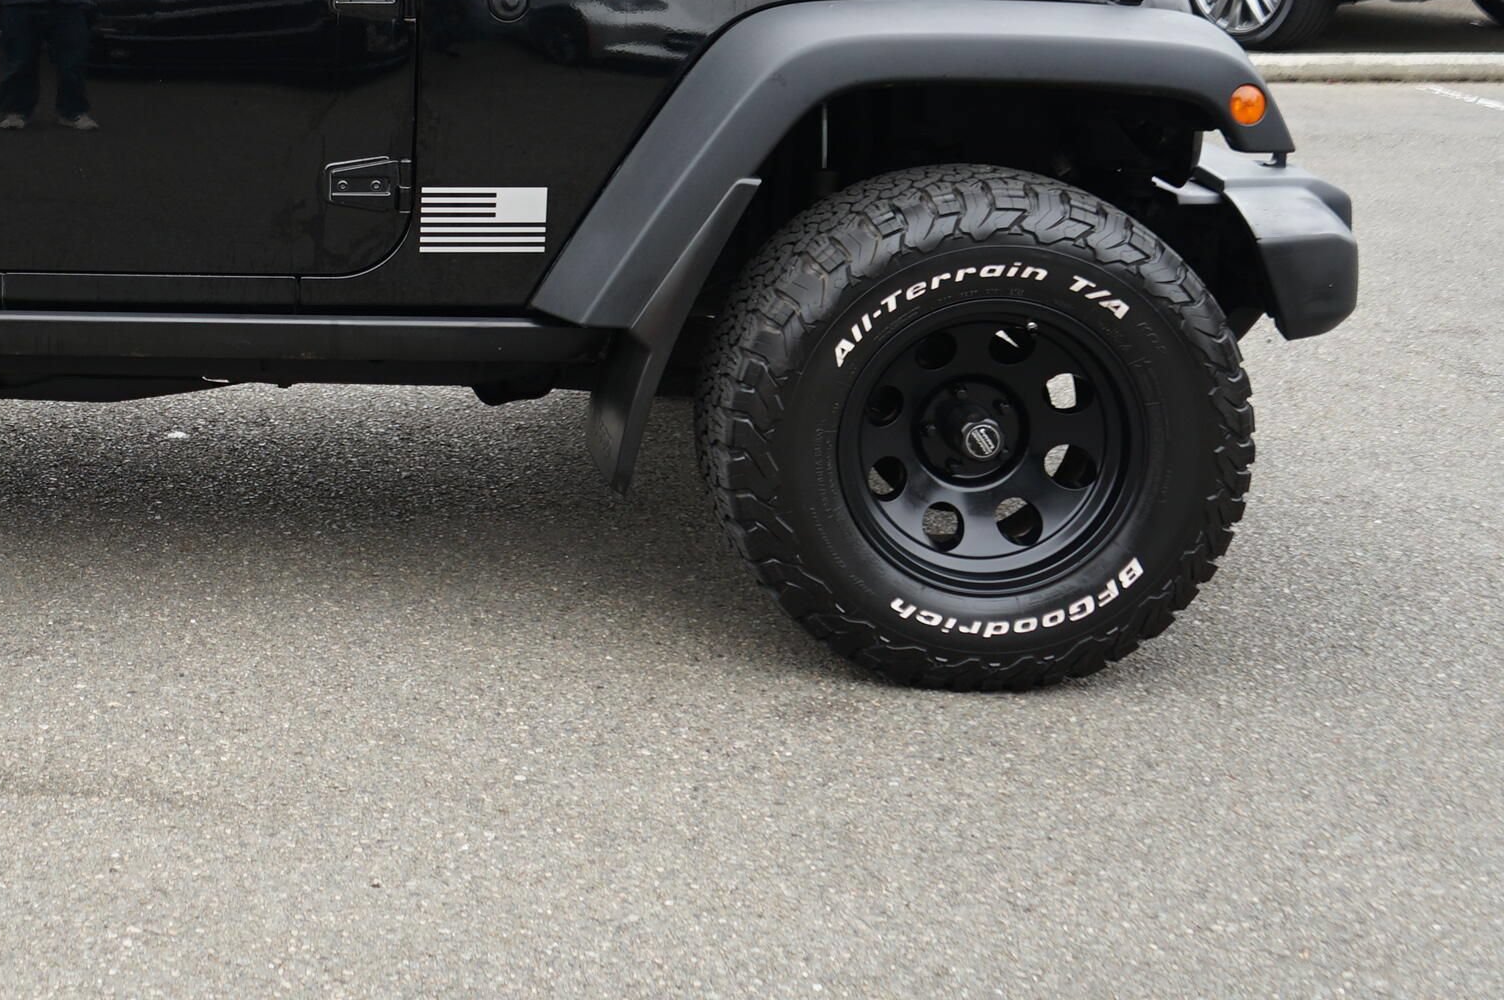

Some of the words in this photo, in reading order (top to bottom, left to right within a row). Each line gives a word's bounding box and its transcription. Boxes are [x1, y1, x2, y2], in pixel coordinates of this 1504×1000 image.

[833, 260, 1048, 368] All-Terrain
[1069, 274, 1131, 321] T/A
[889, 556, 1145, 639] BFGoodrich
